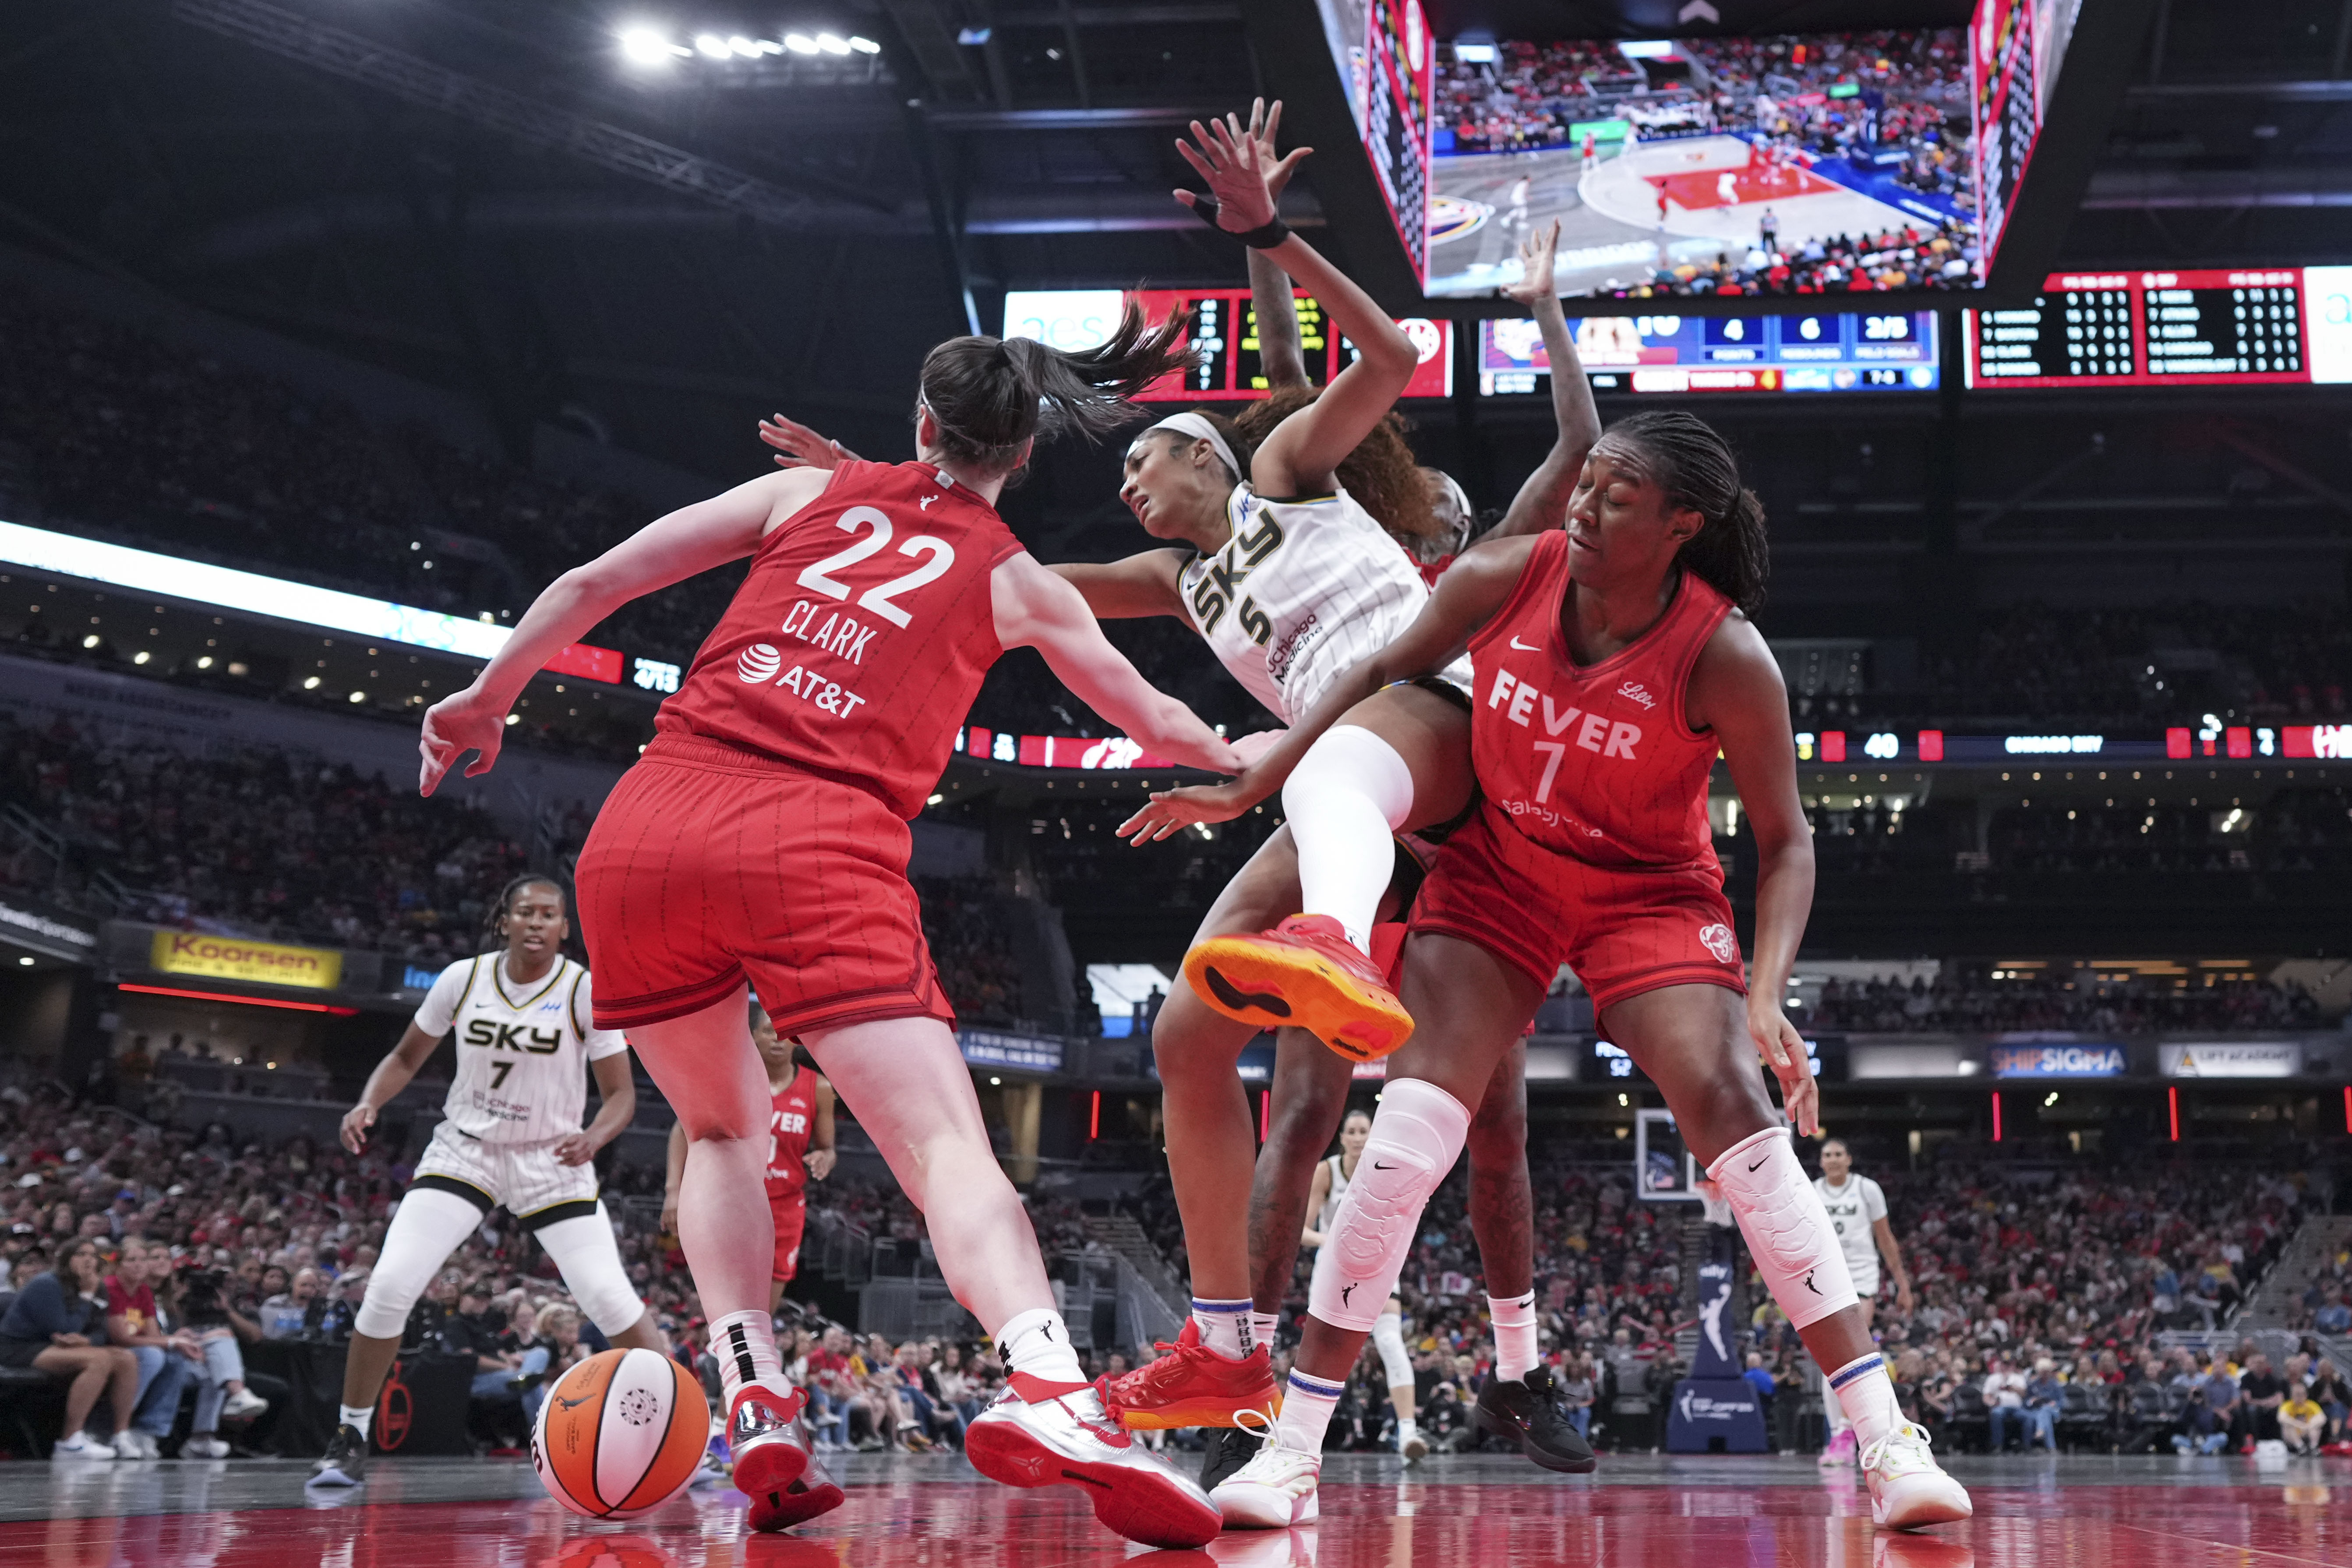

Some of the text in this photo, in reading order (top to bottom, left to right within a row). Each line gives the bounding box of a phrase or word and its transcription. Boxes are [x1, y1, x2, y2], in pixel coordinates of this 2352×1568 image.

[1723, 319, 1744, 340] 4
[1800, 317, 1820, 340] 6
[796, 505, 955, 631] 22
[1193, 507, 1285, 638] SKY
[782, 600, 877, 665] CLARK
[1239, 593, 1272, 647] 5
[1275, 625, 1323, 685] Medicine
[775, 665, 866, 719] AT&T
[1488, 668, 1642, 760] FEVER
[1617, 682, 1656, 711] Lilly
[1864, 733, 1899, 758] 40
[1534, 740, 1566, 804] 7
[173, 934, 318, 971] Koorsen
[464, 1019, 561, 1056] SKY
[490, 1062, 514, 1090] 7
[771, 1110, 807, 1135] VER
